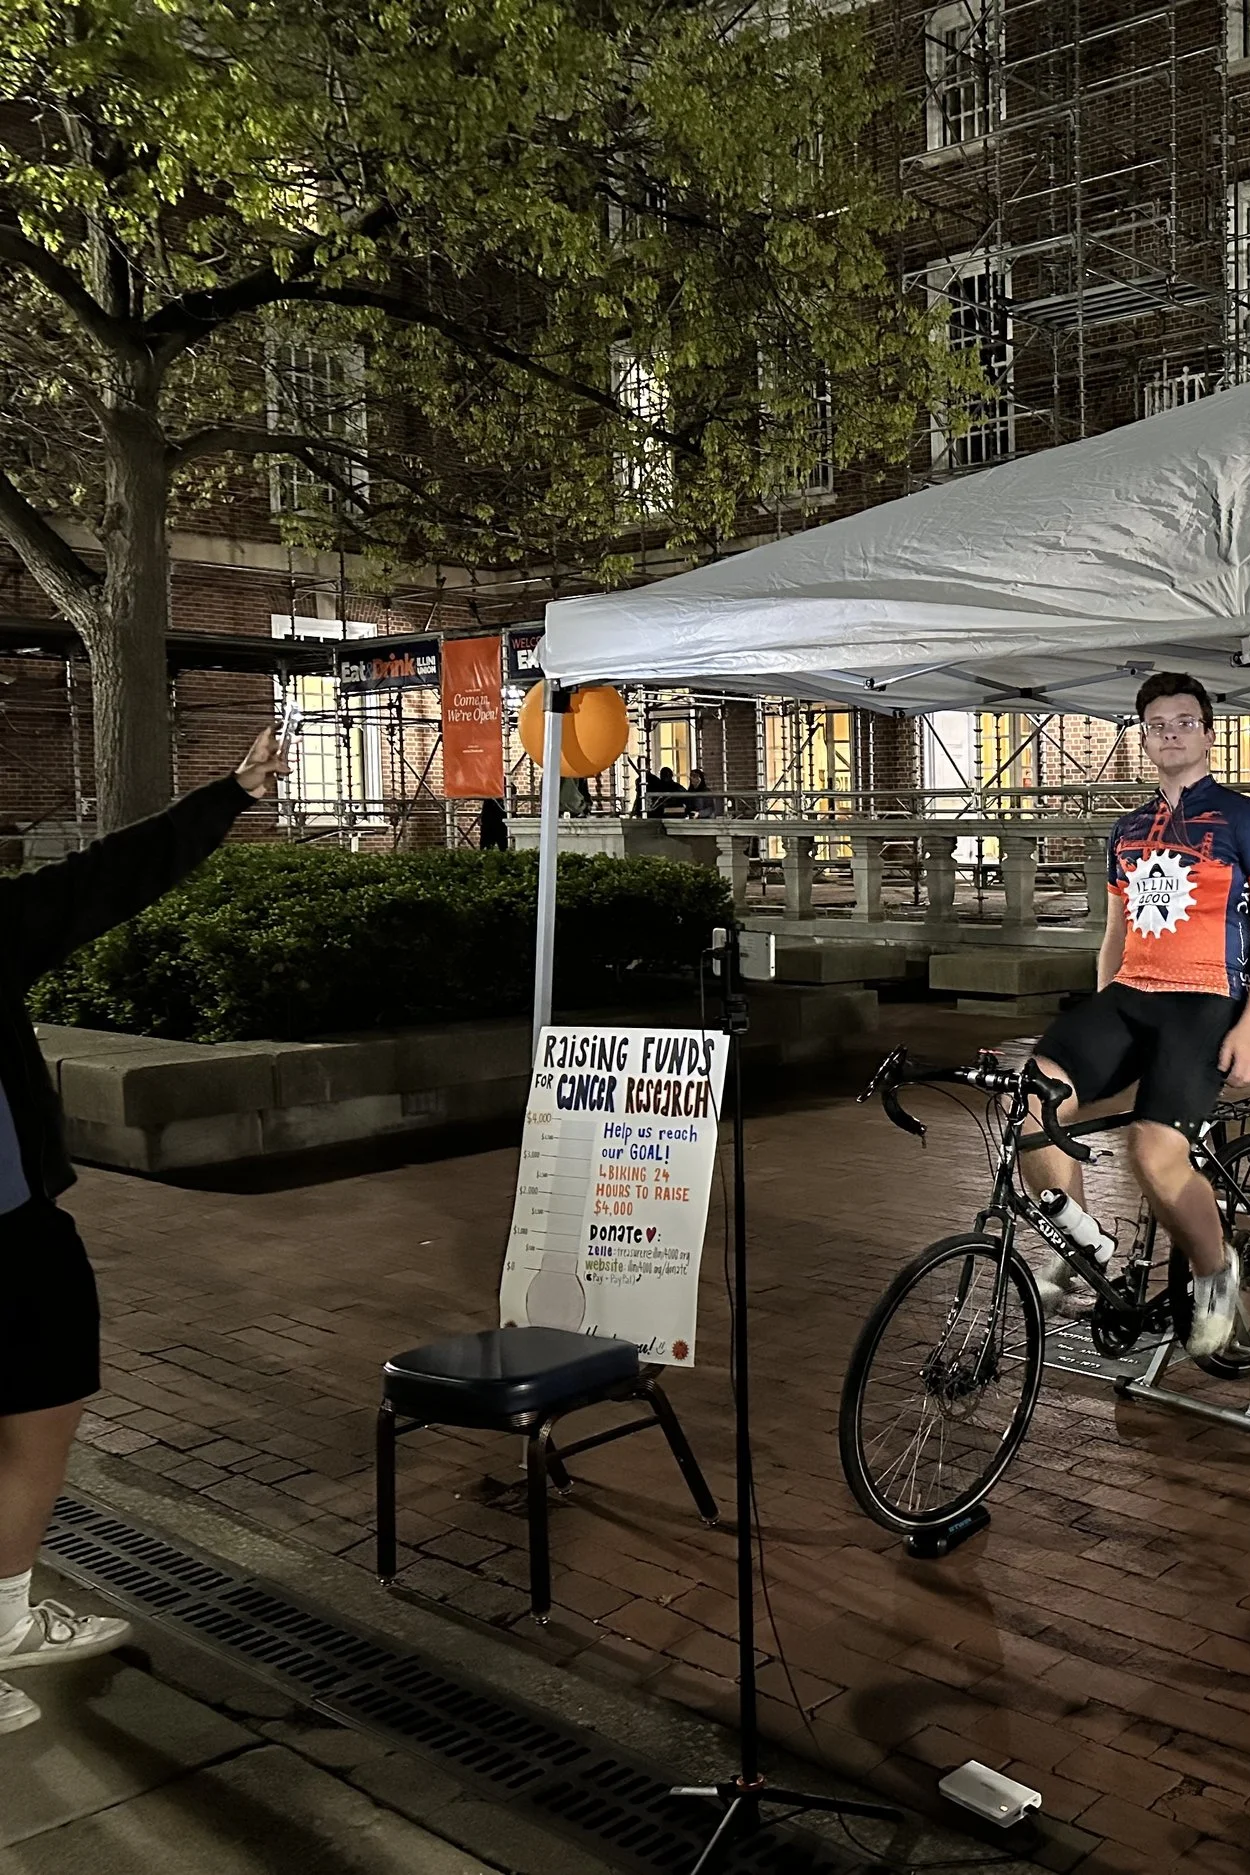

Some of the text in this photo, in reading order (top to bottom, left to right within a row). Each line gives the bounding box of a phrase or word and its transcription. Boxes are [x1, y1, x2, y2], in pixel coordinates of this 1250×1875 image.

[417, 656, 436, 666] ILLINI
[417, 666, 437, 675] UNION
[453, 693, 480, 707] Come
[448, 707, 498, 724] We're Open!
[1136, 879, 1179, 892] ILLINI
[641, 1037, 715, 1076] FUNDS
[535, 1073, 554, 1089] FOR
[527, 1110, 551, 1124] $4,000
[603, 1122, 697, 1145] Help us reach
[602, 1143, 669, 1164] our GOAL!
[608, 1165, 670, 1182] BIKING 24
[596, 1183, 690, 1202] HOURS TO RAISE
[594, 1199, 633, 1216] $4,000
[585, 1258, 626, 1273] website:
